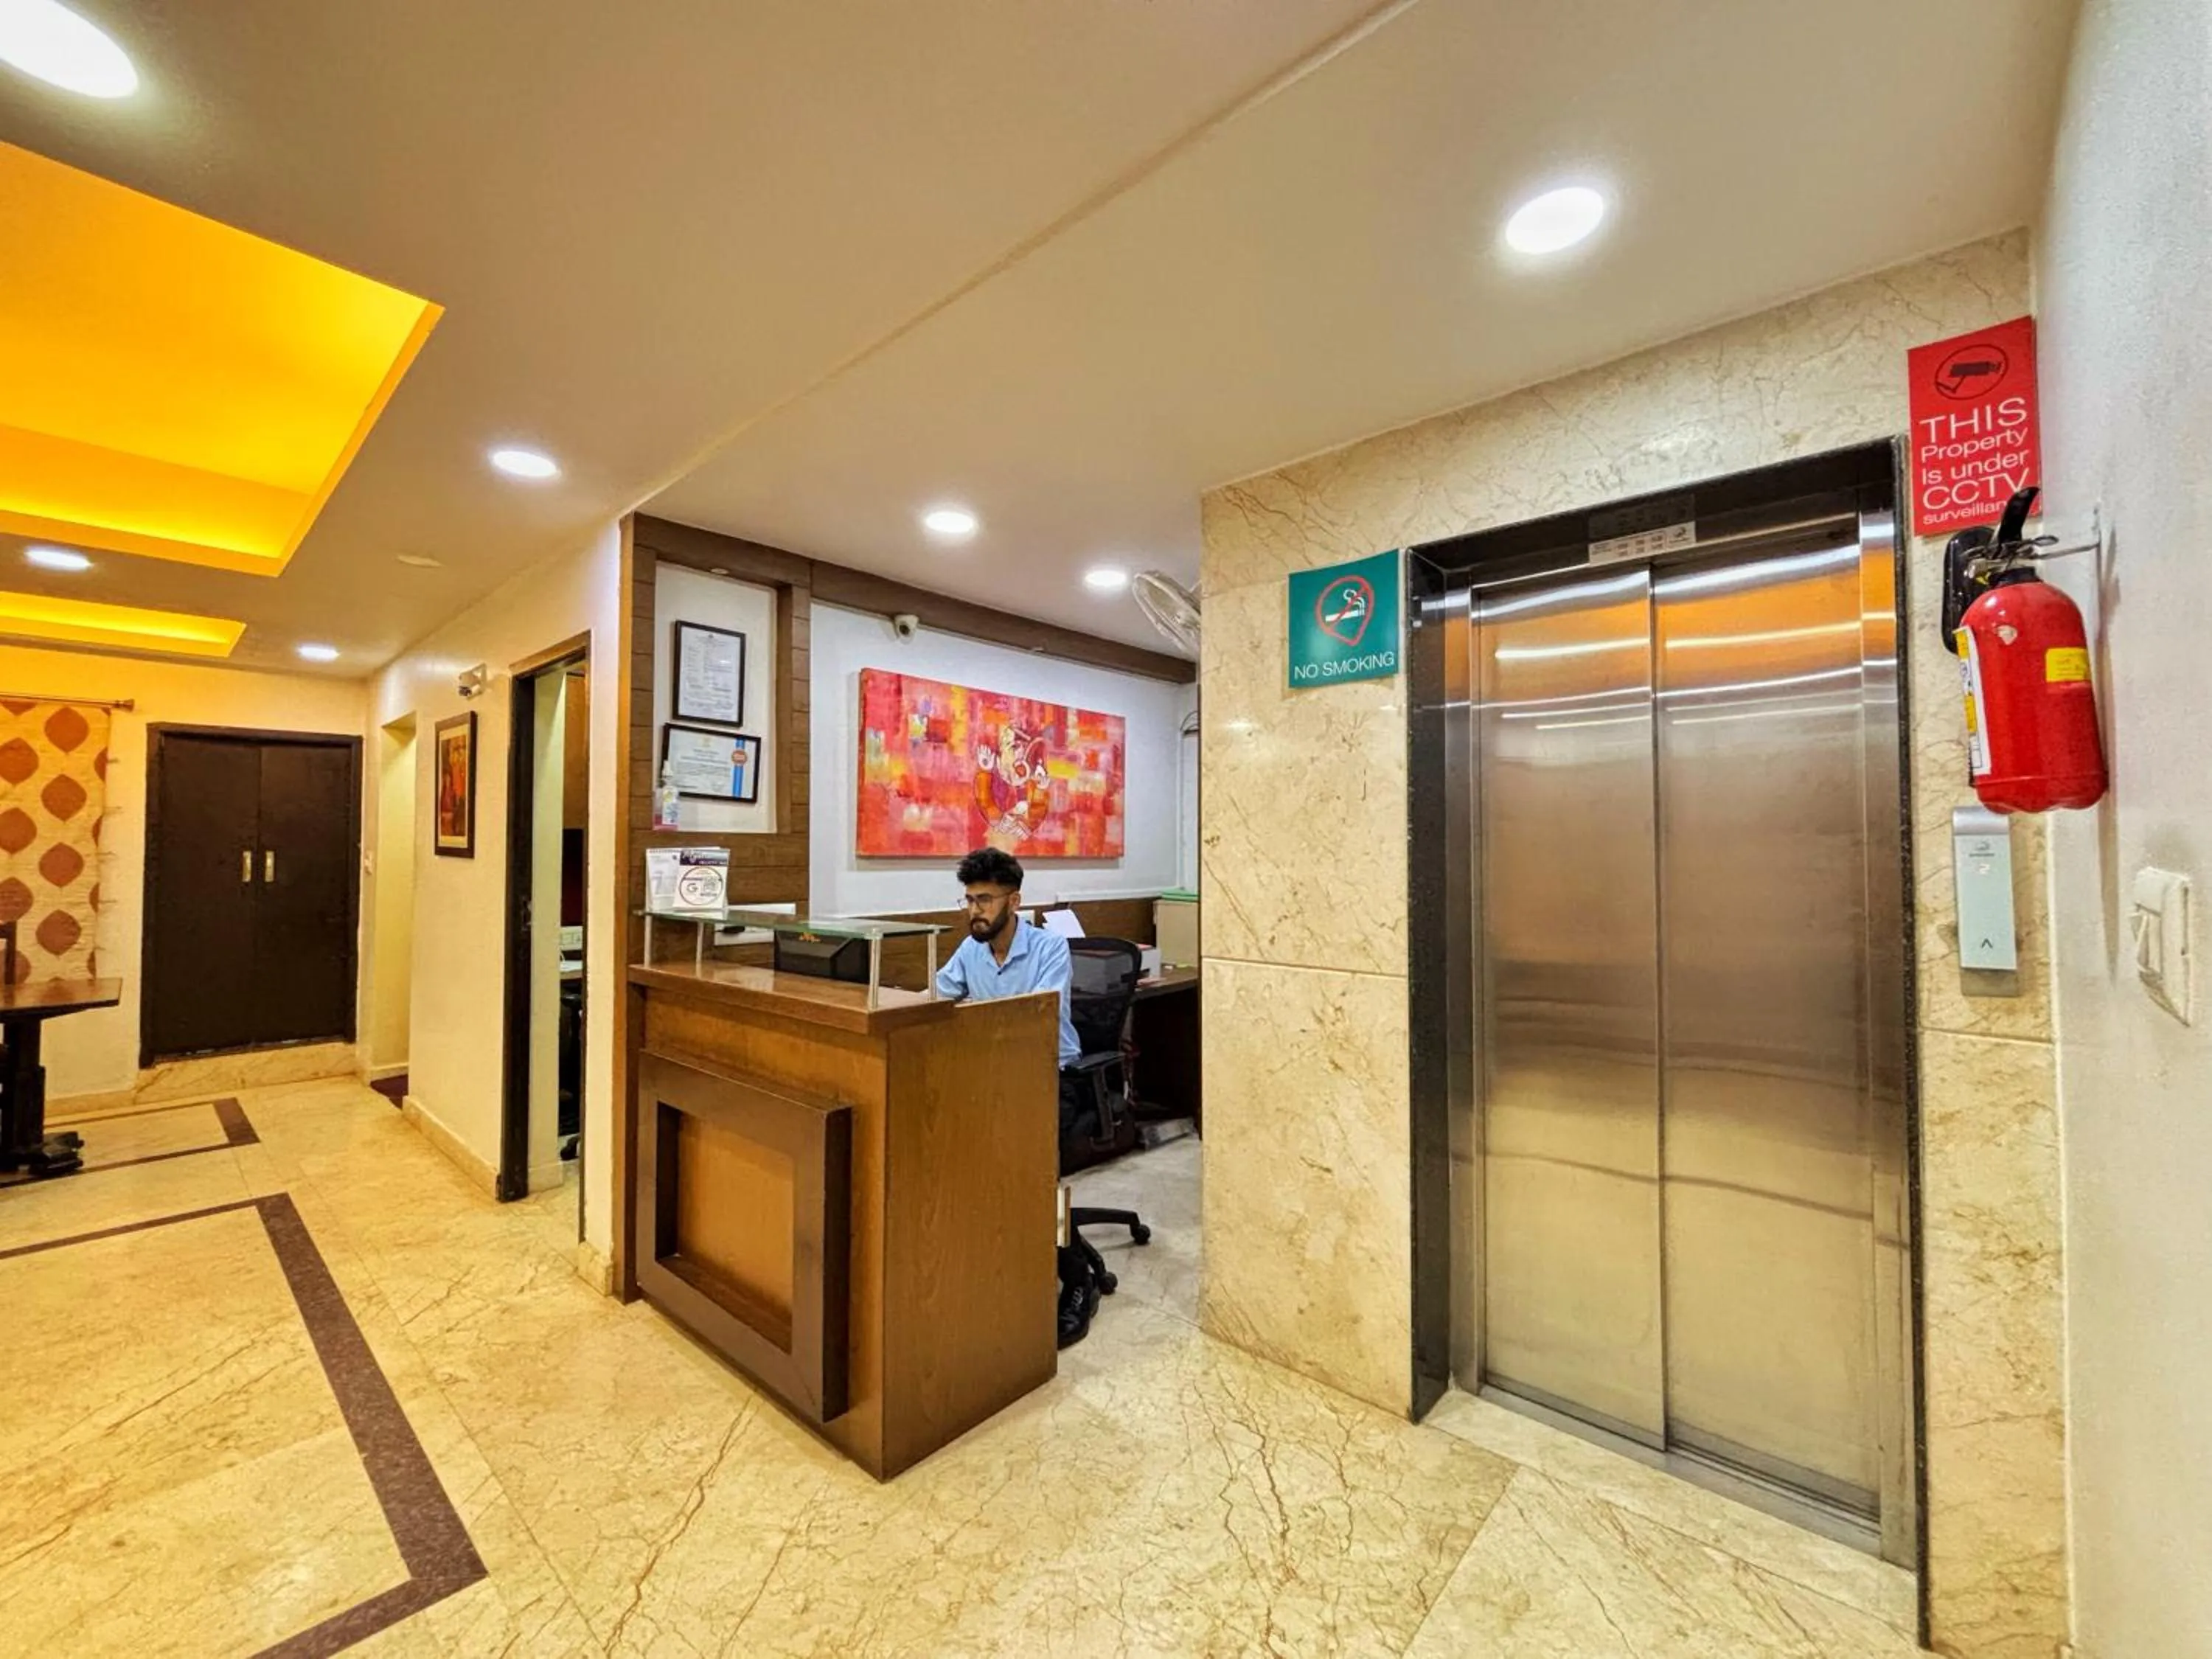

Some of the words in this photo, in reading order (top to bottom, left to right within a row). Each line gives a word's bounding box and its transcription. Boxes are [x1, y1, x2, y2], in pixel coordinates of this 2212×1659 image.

[1919, 397, 2027, 443] THIS
[1921, 427, 2028, 463] Property
[1950, 449, 2029, 479] under
[1922, 467, 2029, 509] CCTV
[1922, 499, 2008, 525] surveillan
[1295, 664, 1318, 680] NO
[1322, 651, 1394, 676] SMOKING
